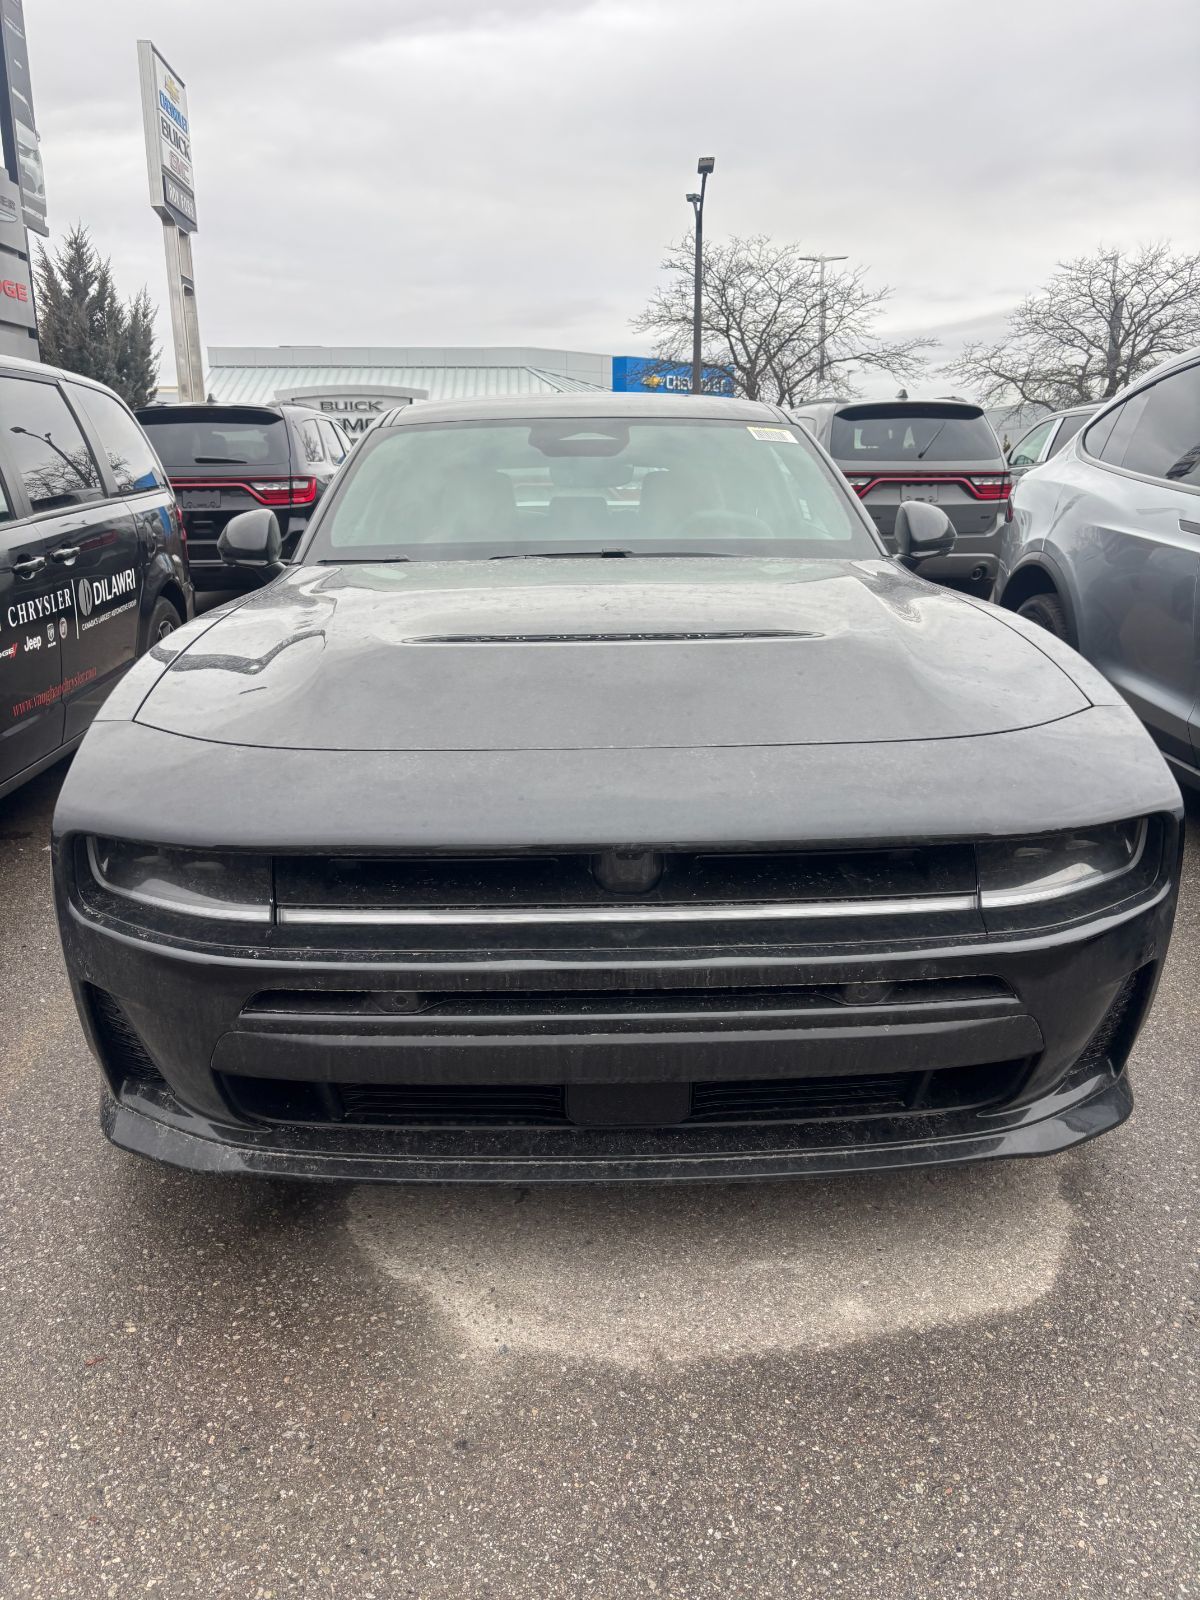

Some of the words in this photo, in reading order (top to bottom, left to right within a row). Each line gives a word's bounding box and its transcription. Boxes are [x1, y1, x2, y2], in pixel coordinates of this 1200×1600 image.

[160, 114, 191, 162] BUICK
[0, 279, 28, 302] GE
[320, 400, 384, 412] BUICK
[93, 568, 136, 605] DILAWRI
[8, 588, 72, 628] CHRYSLER
[0, 646, 15, 658] GE
[24, 636, 42, 652] Jeep
